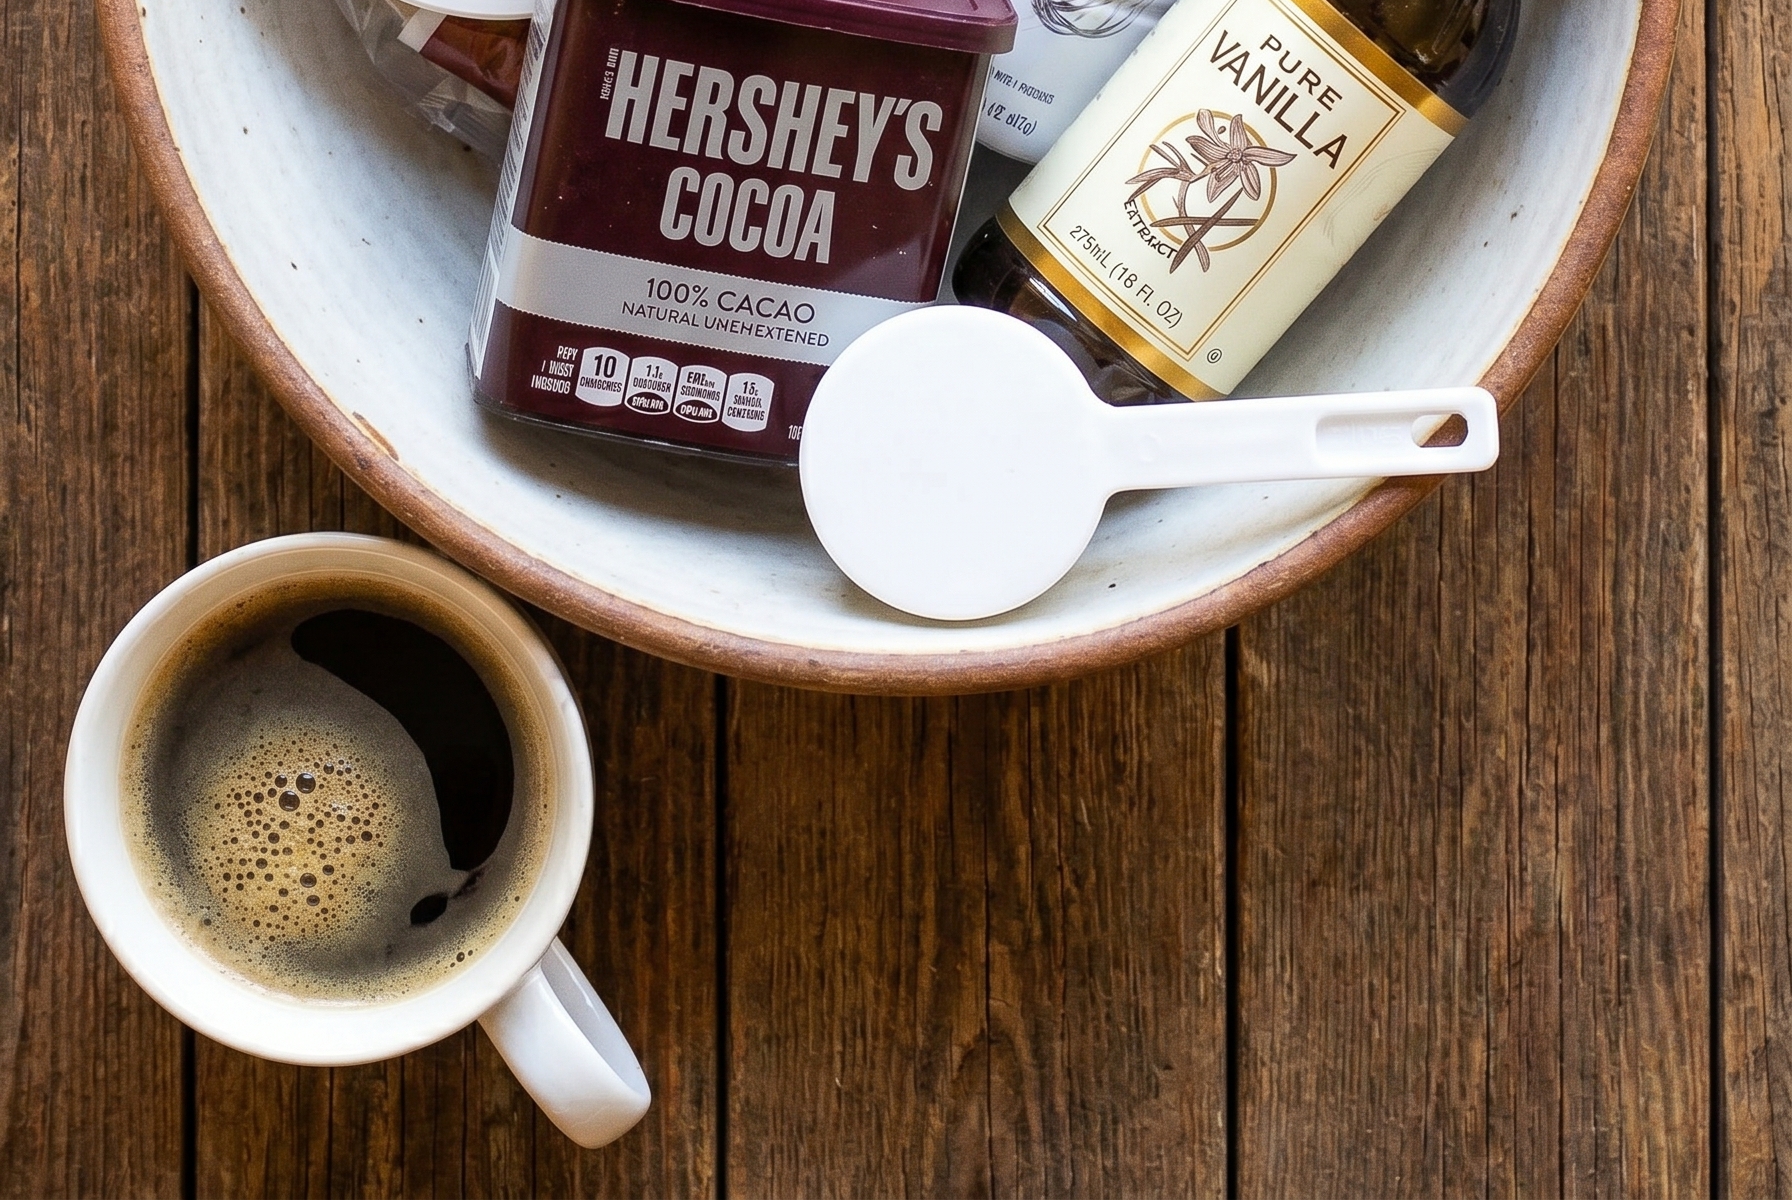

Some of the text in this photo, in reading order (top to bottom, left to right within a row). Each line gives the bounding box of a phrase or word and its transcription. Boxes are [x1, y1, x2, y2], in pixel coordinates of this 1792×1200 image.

[1209, 29, 1349, 170] VANILLA
[1259, 33, 1344, 112] PURE
[604, 49, 944, 191] HERSHEY'S
[659, 166, 837, 265] COCOA
[621, 301, 700, 327] NATURAL
[646, 277, 816, 324] 100% CACAO
[1156, 300, 1184, 330] OZ)
[594, 353, 617, 379] 10
